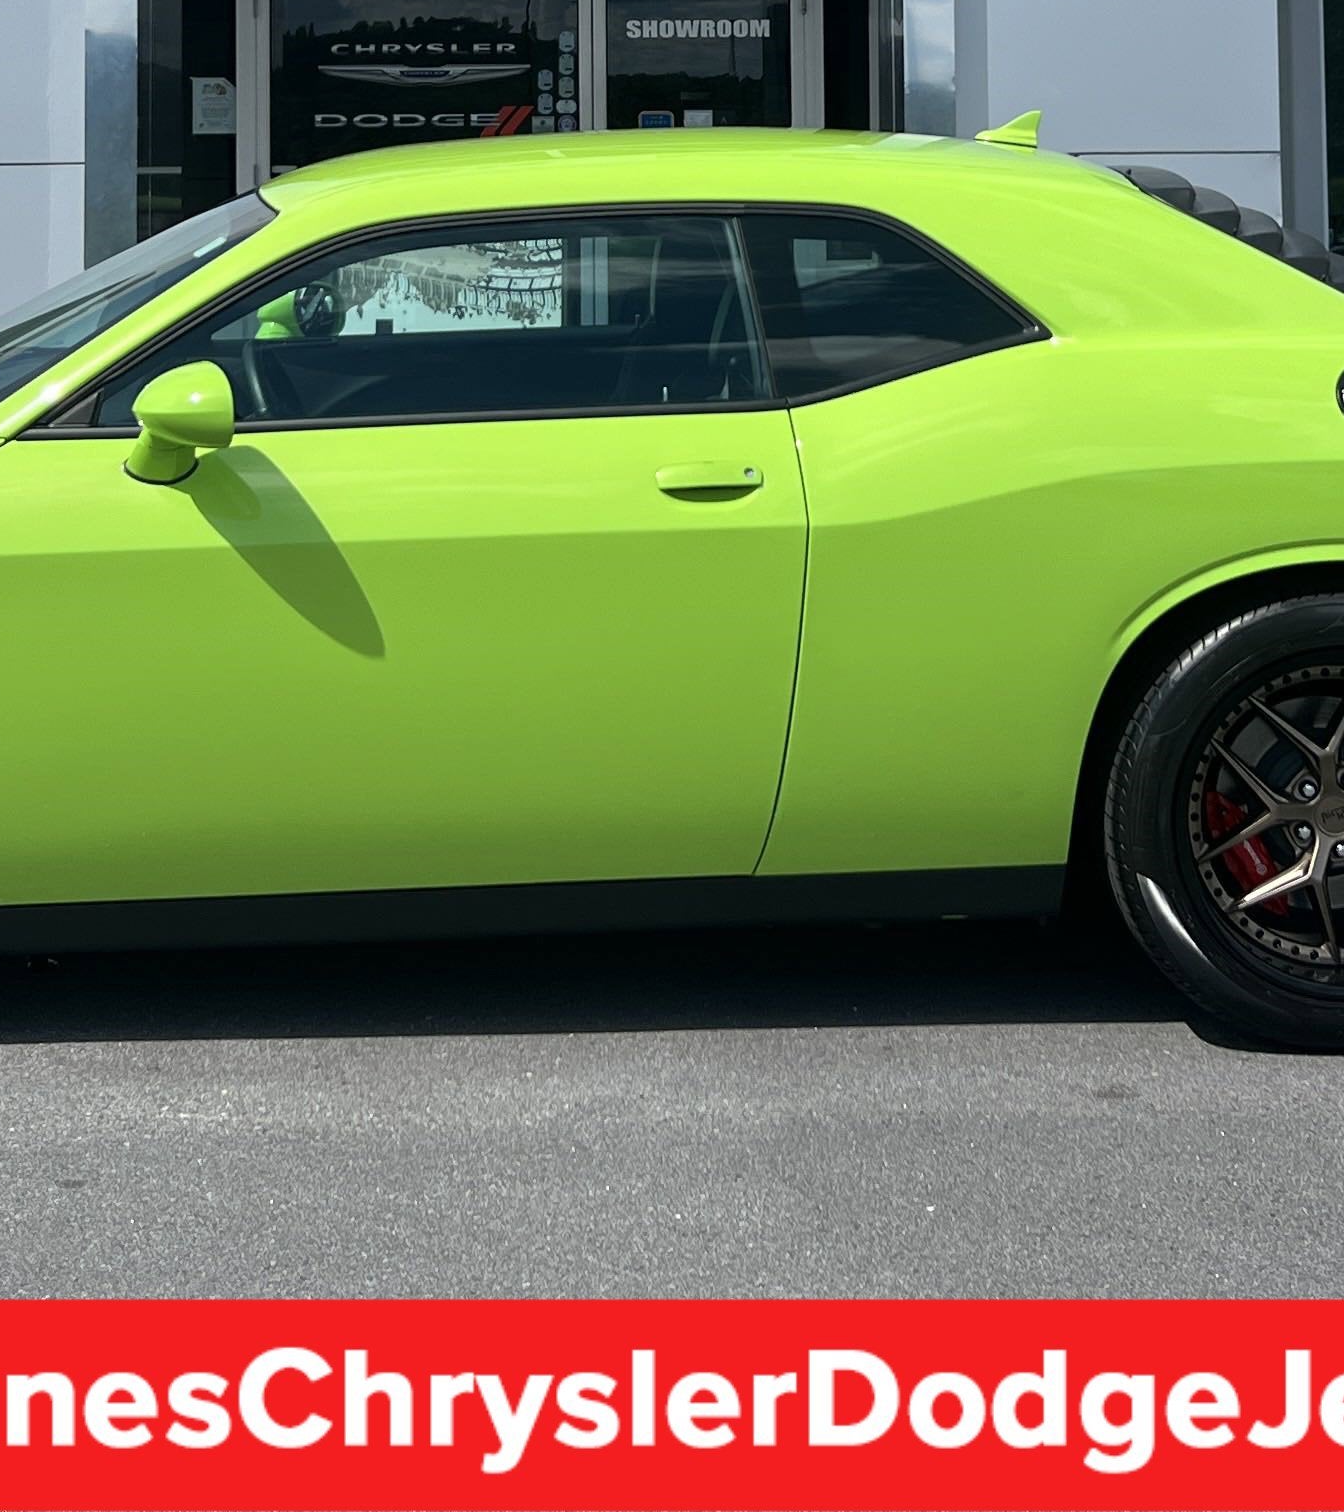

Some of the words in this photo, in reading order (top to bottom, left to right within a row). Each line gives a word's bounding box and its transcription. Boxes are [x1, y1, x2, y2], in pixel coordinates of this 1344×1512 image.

[625, 17, 771, 41] SHOWROOM
[330, 43, 517, 56] CHRYSLER
[313, 113, 502, 128] DODGE
